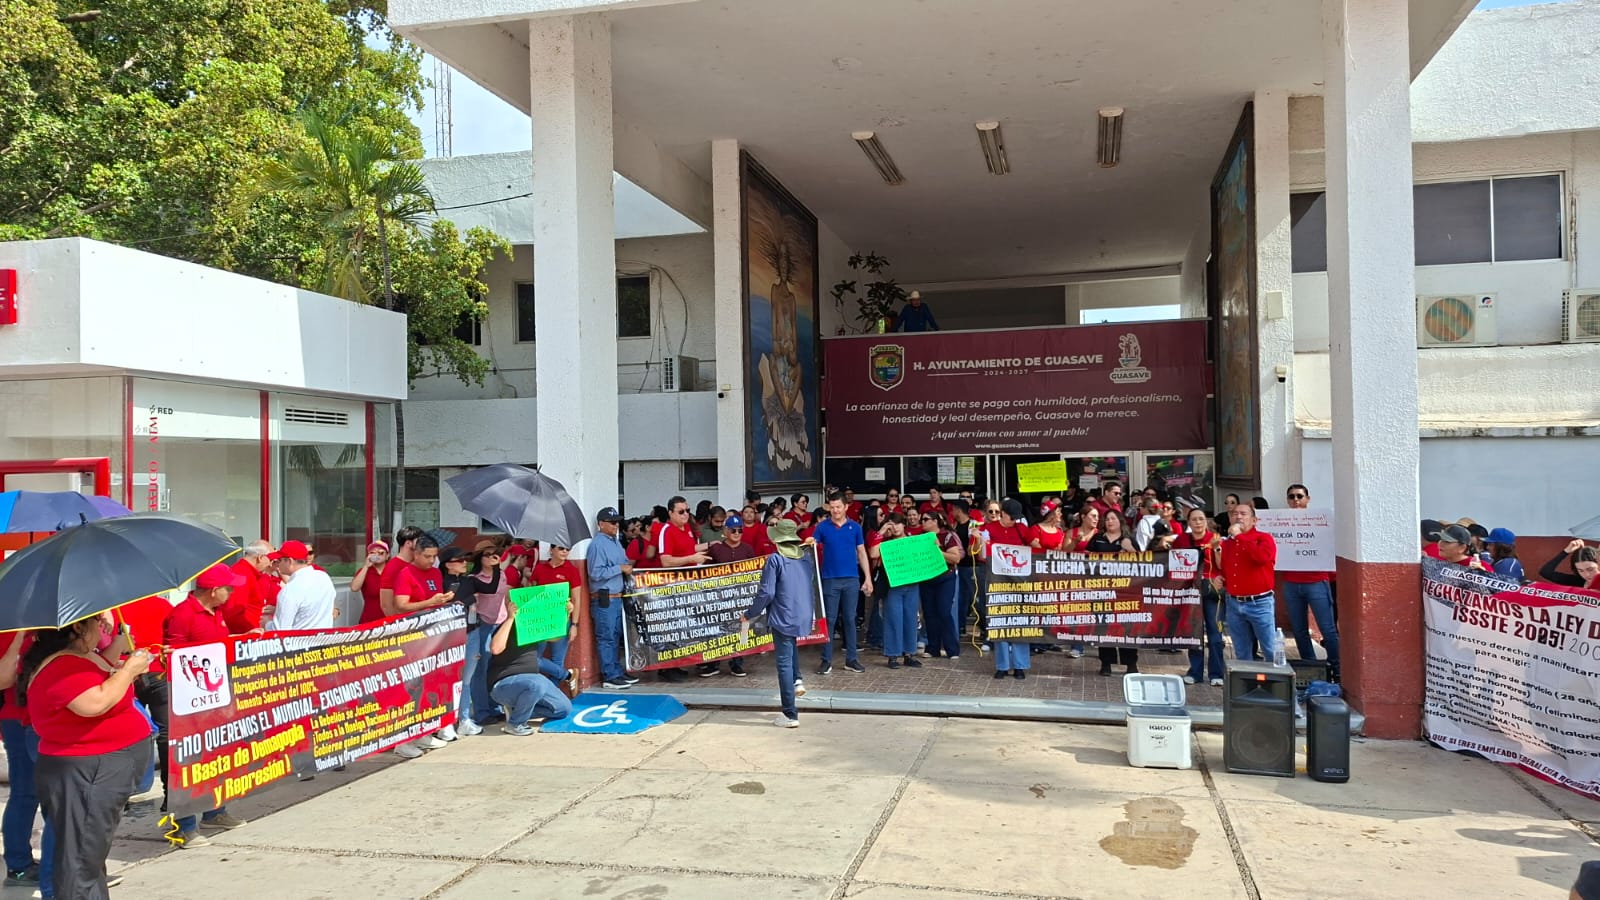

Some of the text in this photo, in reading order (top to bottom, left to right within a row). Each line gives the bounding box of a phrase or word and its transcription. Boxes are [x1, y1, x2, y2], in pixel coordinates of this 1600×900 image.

[914, 354, 1104, 370] H. AYUNTAMIENTO DE GUASAVE
[1111, 372, 1150, 380] GUASAVE
[846, 404, 858, 412] La
[860, 402, 908, 411] confianza
[911, 401, 923, 410] de
[926, 401, 935, 410] la
[938, 400, 966, 411] gente
[982, 400, 1010, 412] paga
[1034, 396, 1088, 406] humildad,
[1091, 393, 1182, 406] profesionalismo,
[882, 410, 1140, 424] honestidad y leal desempeño, Guasave lo merece.
[930, 430, 957, 440] ¡Aquí
[959, 430, 996, 438] servimos
[1016, 428, 1042, 437] amor
[1042, 428, 1052, 436] al
[1054, 426, 1090, 438] pueblo!
[1118, 550, 1152, 562] MAYO
[678, 564, 732, 582] A LA LUCHA
[1036, 560, 1164, 578] DE LUCHA Y COMBATIVO
[652, 584, 692, 596] APOYO TOTAL
[988, 578, 1131, 592] ABROGACIÓN DE LA LEY DEL ISSSTE 2007
[644, 586, 750, 612] AUMENTO SALARIAL DEL 100% AL
[988, 590, 1116, 604] AUMENTO SALARIAL DE EMERGENCIA
[645, 601, 736, 622] ABROGACIÓN DE LA REFORMA
[988, 600, 1140, 616] MEJORES SERVICIOS EN EL ISSSTE
[648, 618, 688, 633] ABROGACIÓN
[688, 618, 698, 627] DE
[697, 616, 706, 625] LA
[708, 614, 720, 624] LEY
[720, 612, 732, 622] DEL
[1041, 614, 1061, 625] AÑOS
[1062, 614, 1096, 625] MUJERES
[1097, 614, 1104, 624] Y
[1116, 612, 1152, 622] HOMBRES
[1452, 606, 1508, 634] ISSSTE
[1528, 606, 1551, 626] LA
[1556, 611, 1585, 635] LEY
[650, 631, 690, 643] RECHAZO AL
[988, 629, 998, 638] NO
[1000, 628, 1006, 638] A
[1006, 628, 1020, 638] LAS
[235, 638, 283, 661] Exigimos
[673, 638, 718, 658] DERECHOS SE
[702, 644, 736, 660] GOBIERNE
[1448, 632, 1487, 646] nuestro
[1489, 642, 1530, 657] derecho
[1475, 648, 1498, 658] para
[232, 644, 364, 679] Abrogación de la ley del ISSSTE Sistema
[234, 662, 339, 695] Abrogación de la Reforma Educativa
[1454, 663, 1472, 671] por
[1474, 666, 1507, 680] tiempo
[1508, 676, 1520, 684] de
[1522, 681, 1552, 696] servicio
[191, 692, 220, 708] CNTE
[262, 686, 288, 704] Salarial
[288, 684, 299, 698] del
[204, 656, 436, 752] QUEREMOS EL MUNDIAL, EXIGIMOS 100% DE AUMENTO
[310, 718, 320, 730] La
[346, 710, 354, 720] se
[338, 724, 345, 736] la
[366, 710, 390, 727] Nacional
[1494, 708, 1510, 718] con
[1512, 713, 1532, 725] base
[192, 724, 306, 784] Basta de Demagogia
[1432, 733, 1447, 743] QUE
[1478, 744, 1518, 760] EMPLEADO
[214, 762, 286, 808] y Represión
